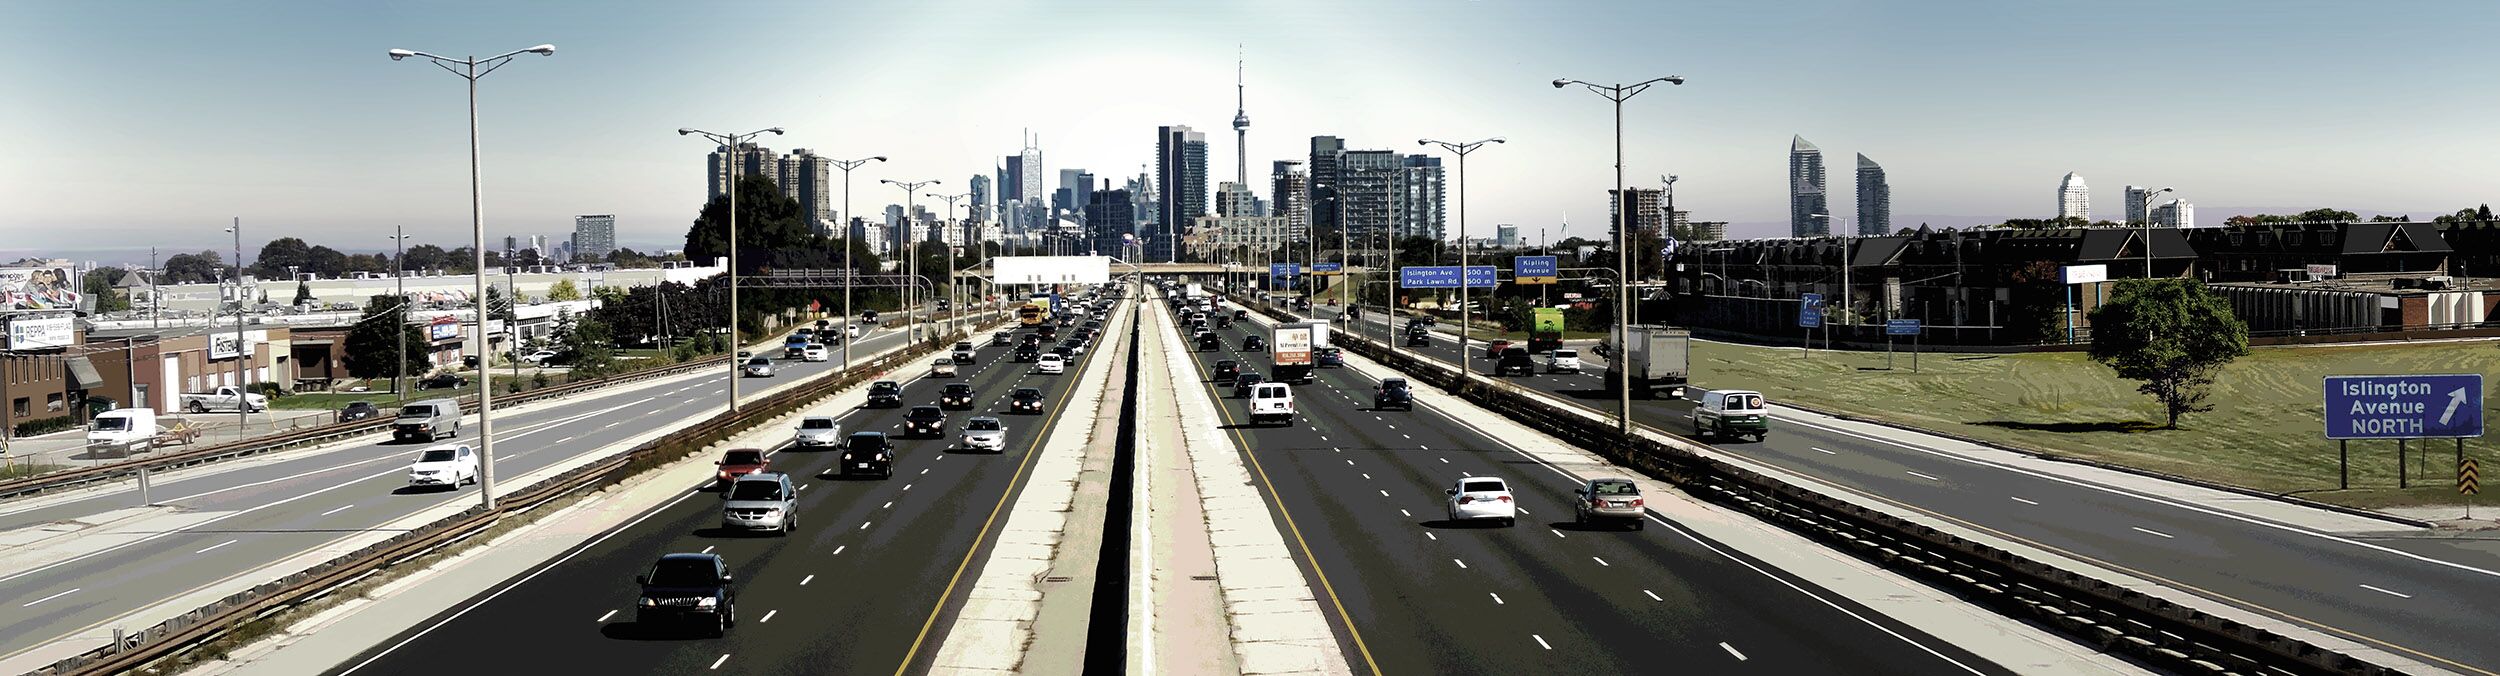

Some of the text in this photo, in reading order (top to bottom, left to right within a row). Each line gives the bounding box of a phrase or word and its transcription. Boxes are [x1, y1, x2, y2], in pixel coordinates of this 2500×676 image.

[1407, 269, 1437, 277] Islington
[26, 325, 46, 338] REPPA
[214, 337, 241, 353] FASTENA
[2342, 380, 2432, 400] Islington
[2350, 400, 2426, 415] Avenue
[2352, 418, 2424, 434] NORTH
